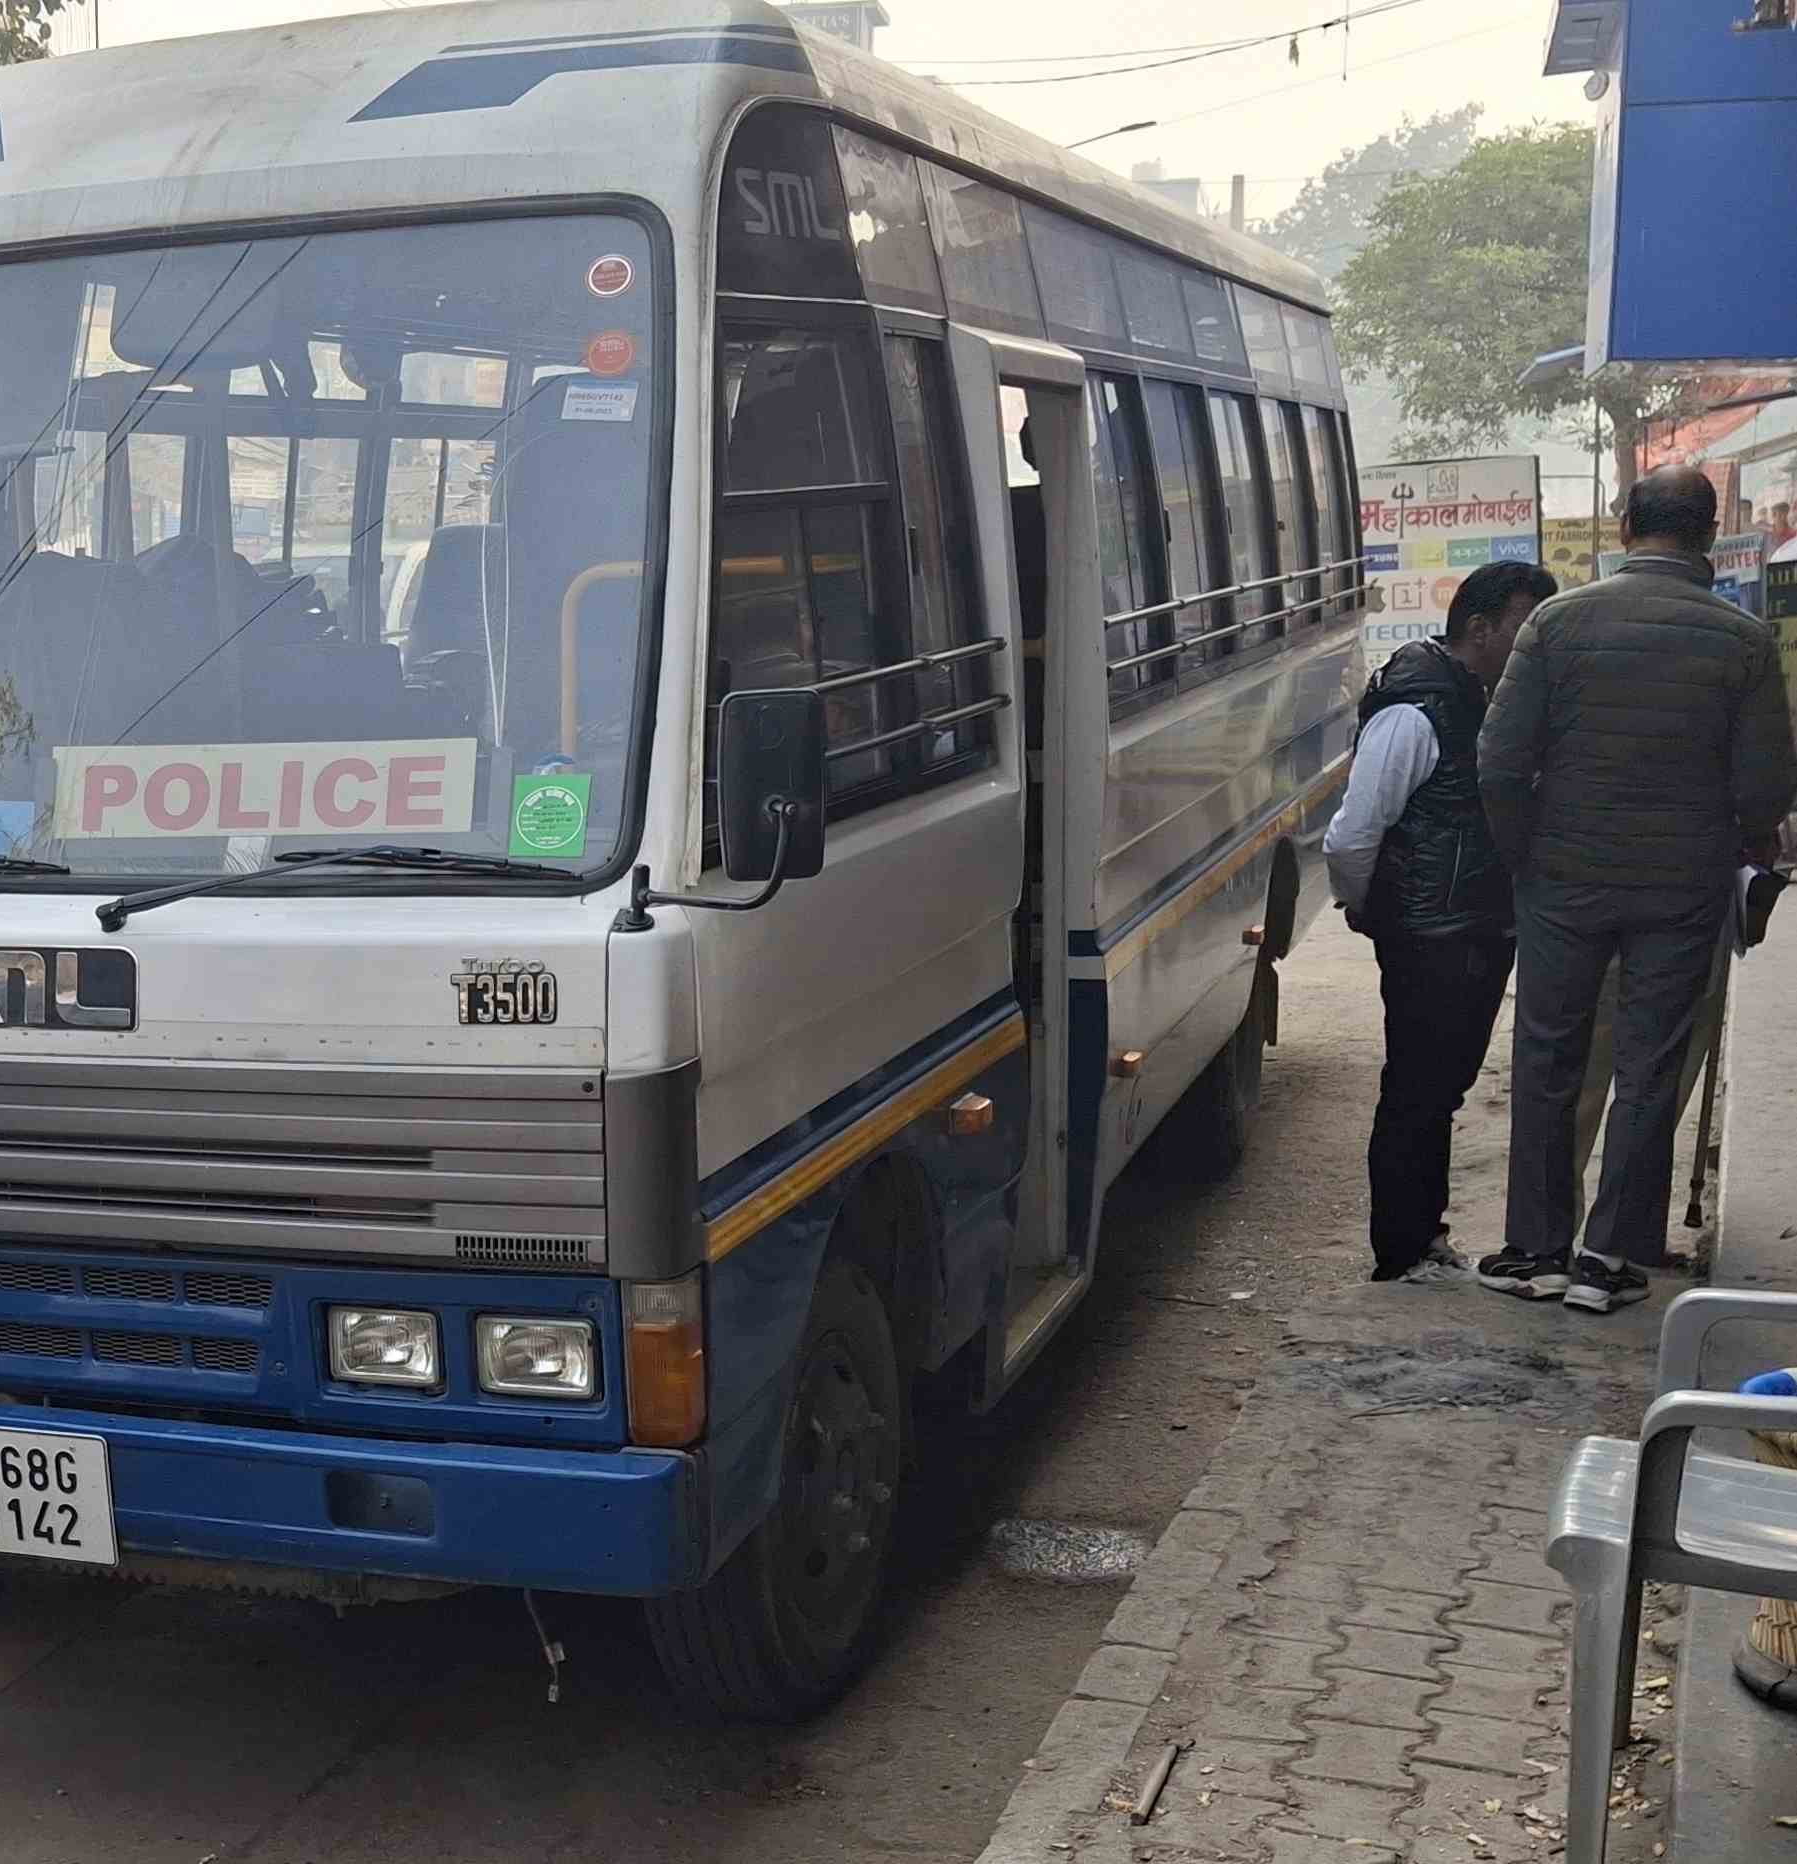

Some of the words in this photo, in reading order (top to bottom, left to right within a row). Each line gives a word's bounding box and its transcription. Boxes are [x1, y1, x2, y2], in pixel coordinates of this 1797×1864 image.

[736, 168, 841, 240] SML
[1498, 540, 1531, 556] vivo
[80, 755, 446, 832] POLICE
[451, 973, 556, 1023] T3500
